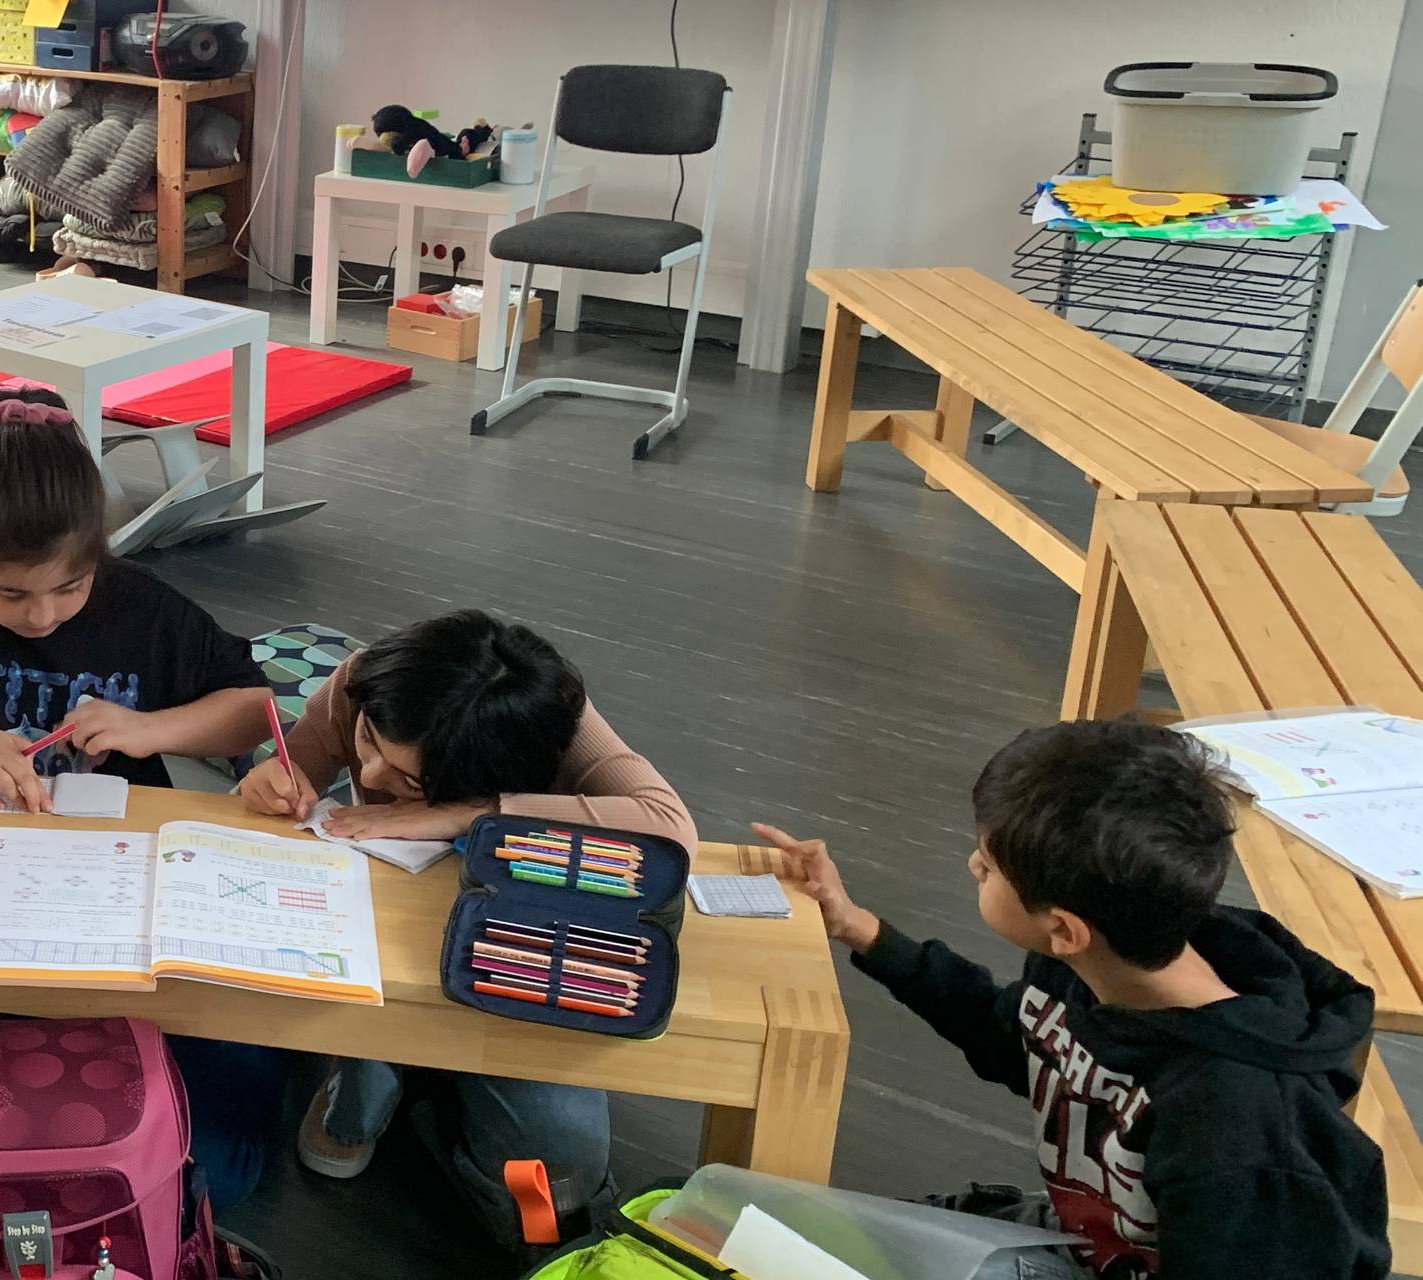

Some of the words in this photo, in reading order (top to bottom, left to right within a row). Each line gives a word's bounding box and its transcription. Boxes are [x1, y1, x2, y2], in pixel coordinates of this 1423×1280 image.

[1018, 985, 1152, 1133] CHAG
[7, 1225, 22, 1237] Step
[22, 1224, 31, 1237] by
[31, 1223, 46, 1235] Step
